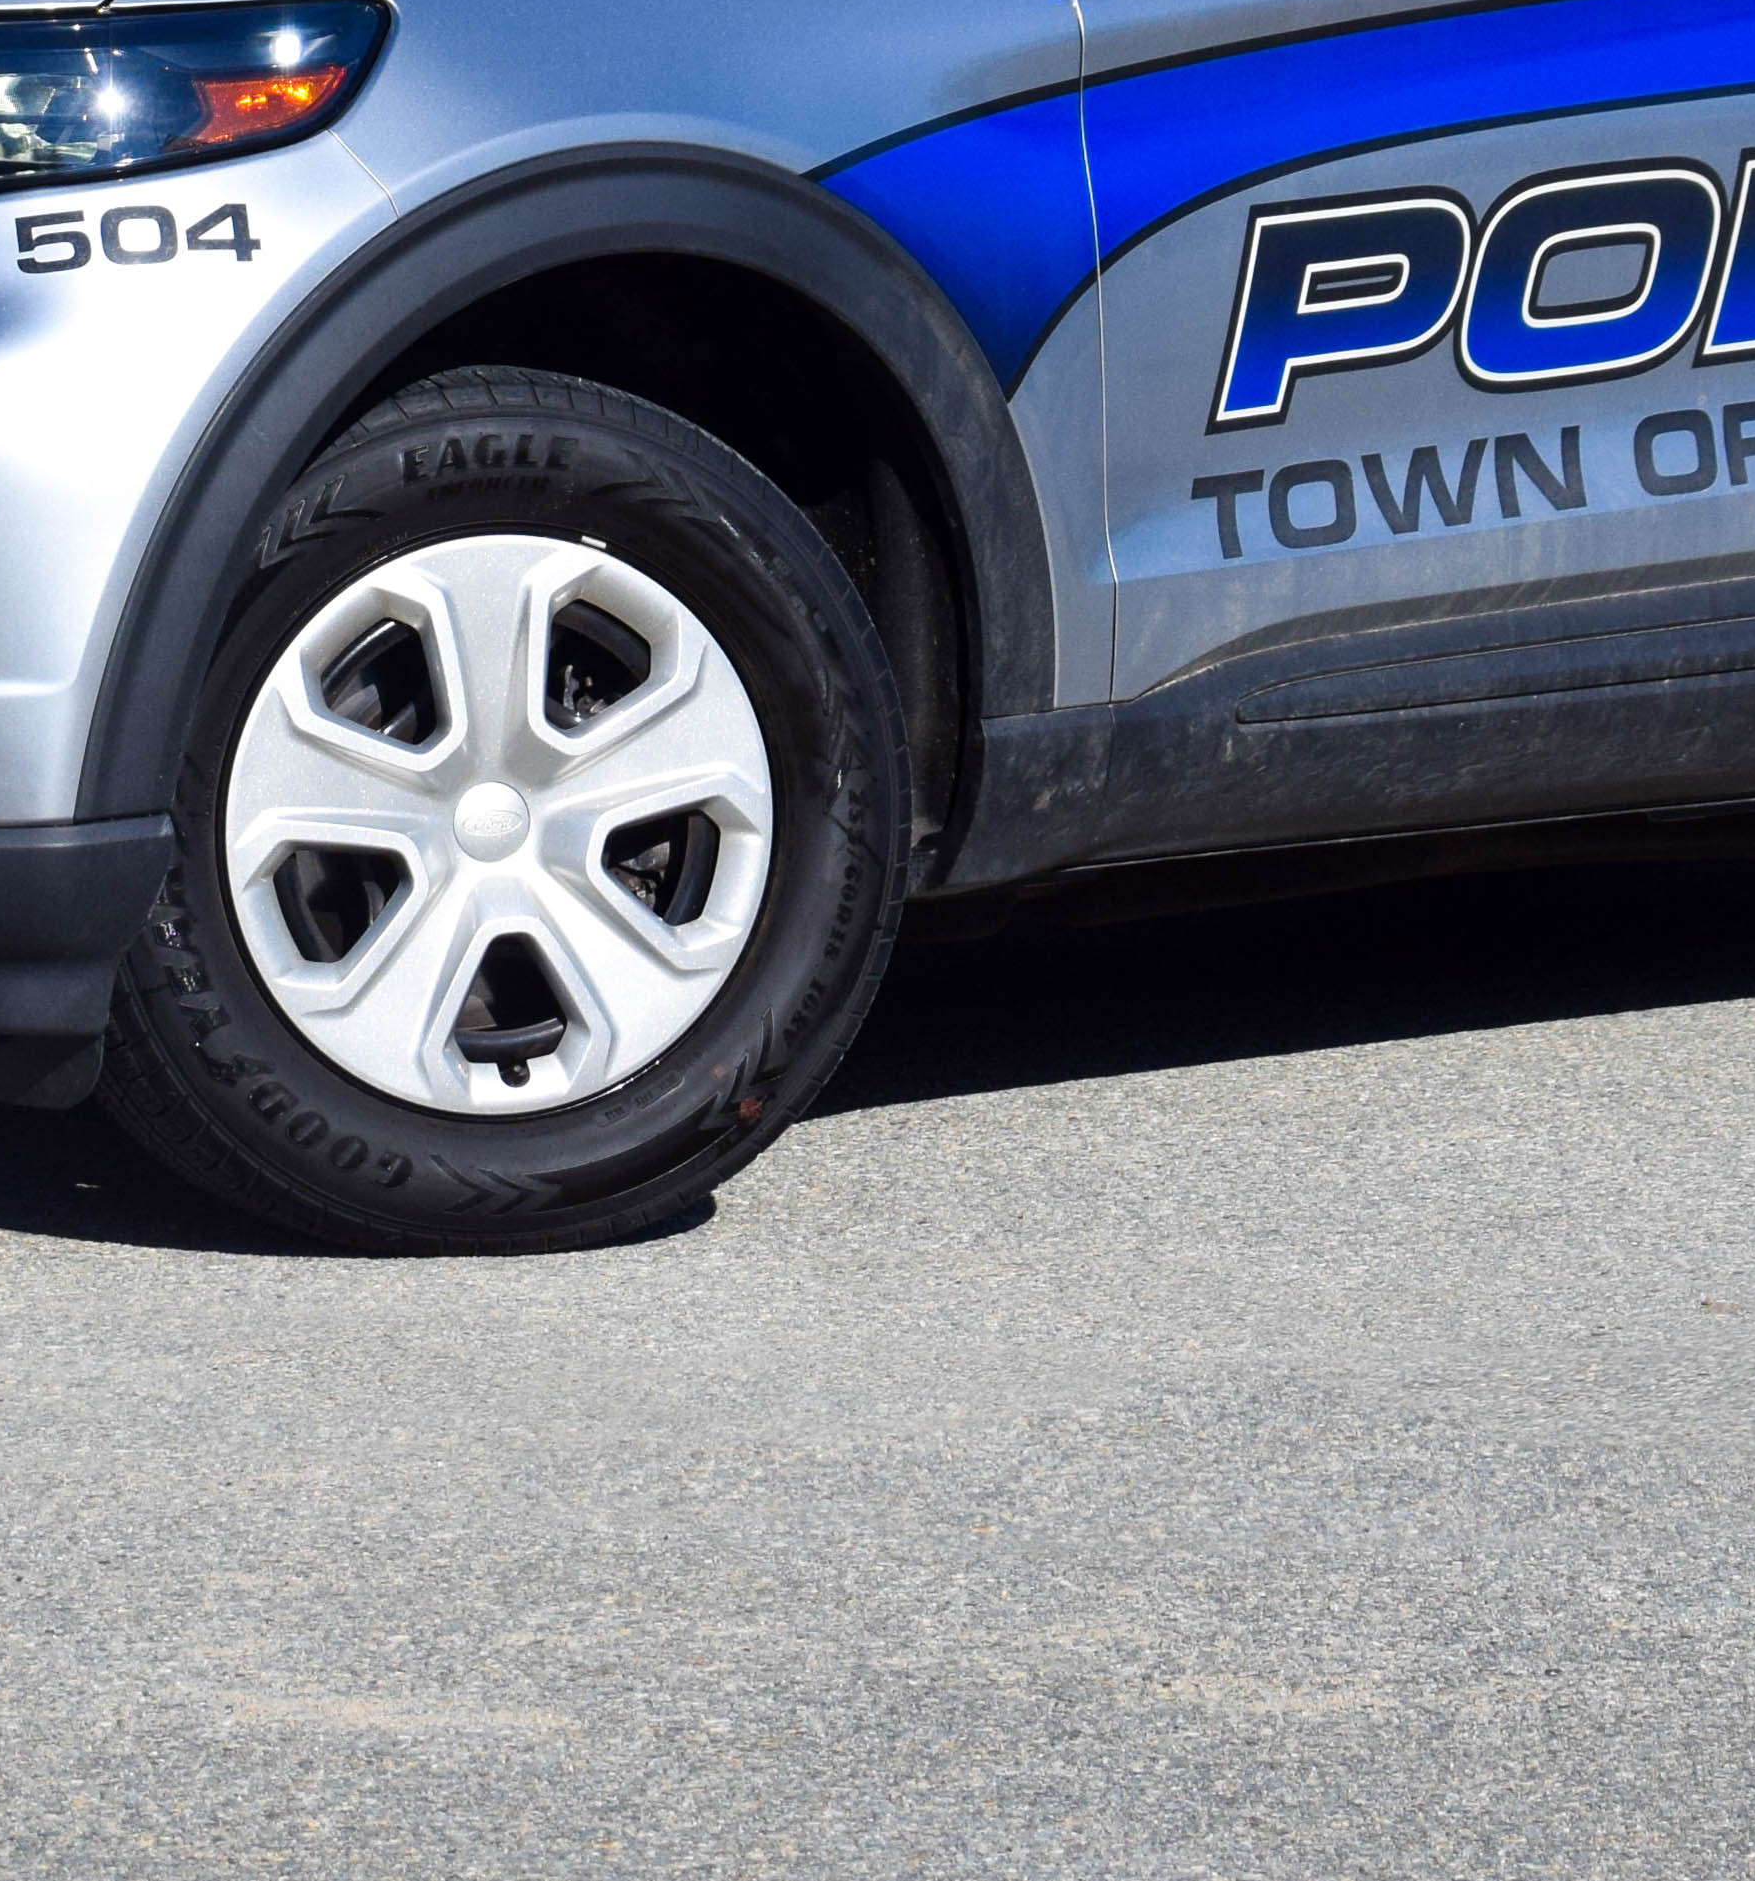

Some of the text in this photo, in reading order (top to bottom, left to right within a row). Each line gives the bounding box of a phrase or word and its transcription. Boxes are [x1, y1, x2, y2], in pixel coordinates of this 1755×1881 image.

[15, 203, 261, 274] 504
[399, 433, 580, 487] EAGLE
[1191, 425, 1588, 561] TOWN
